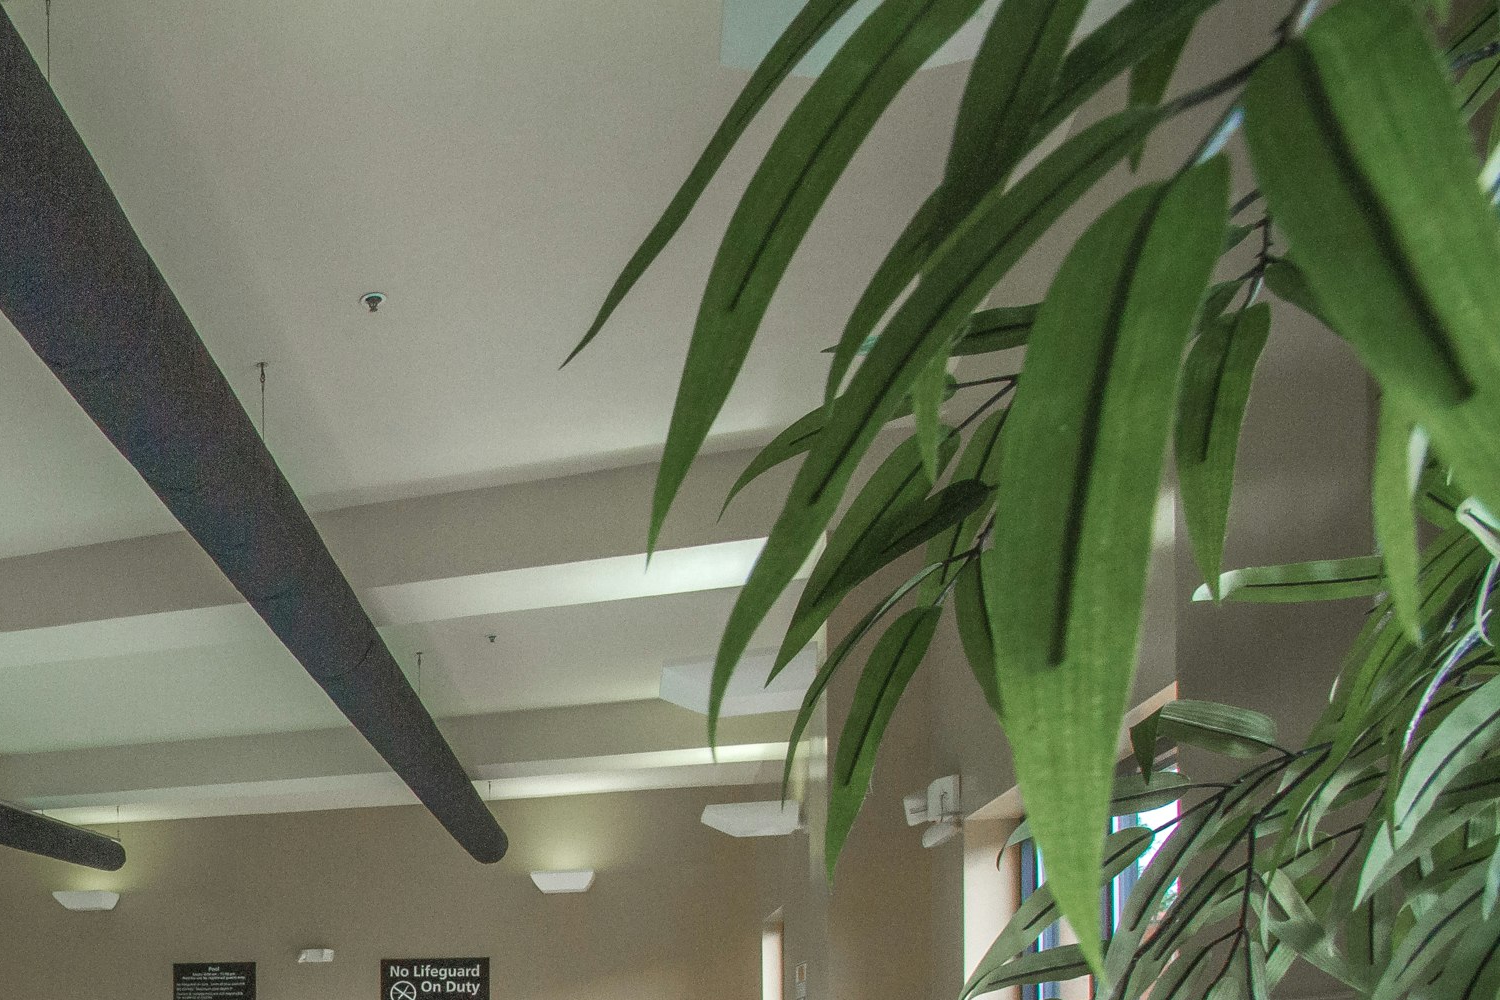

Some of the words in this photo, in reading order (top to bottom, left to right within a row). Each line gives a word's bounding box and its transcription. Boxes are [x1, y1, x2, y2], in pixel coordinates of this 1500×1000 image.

[389, 965, 409, 977] No
[413, 964, 480, 980] Lifeguard
[420, 981, 441, 992] On
[446, 980, 480, 996] Duty
